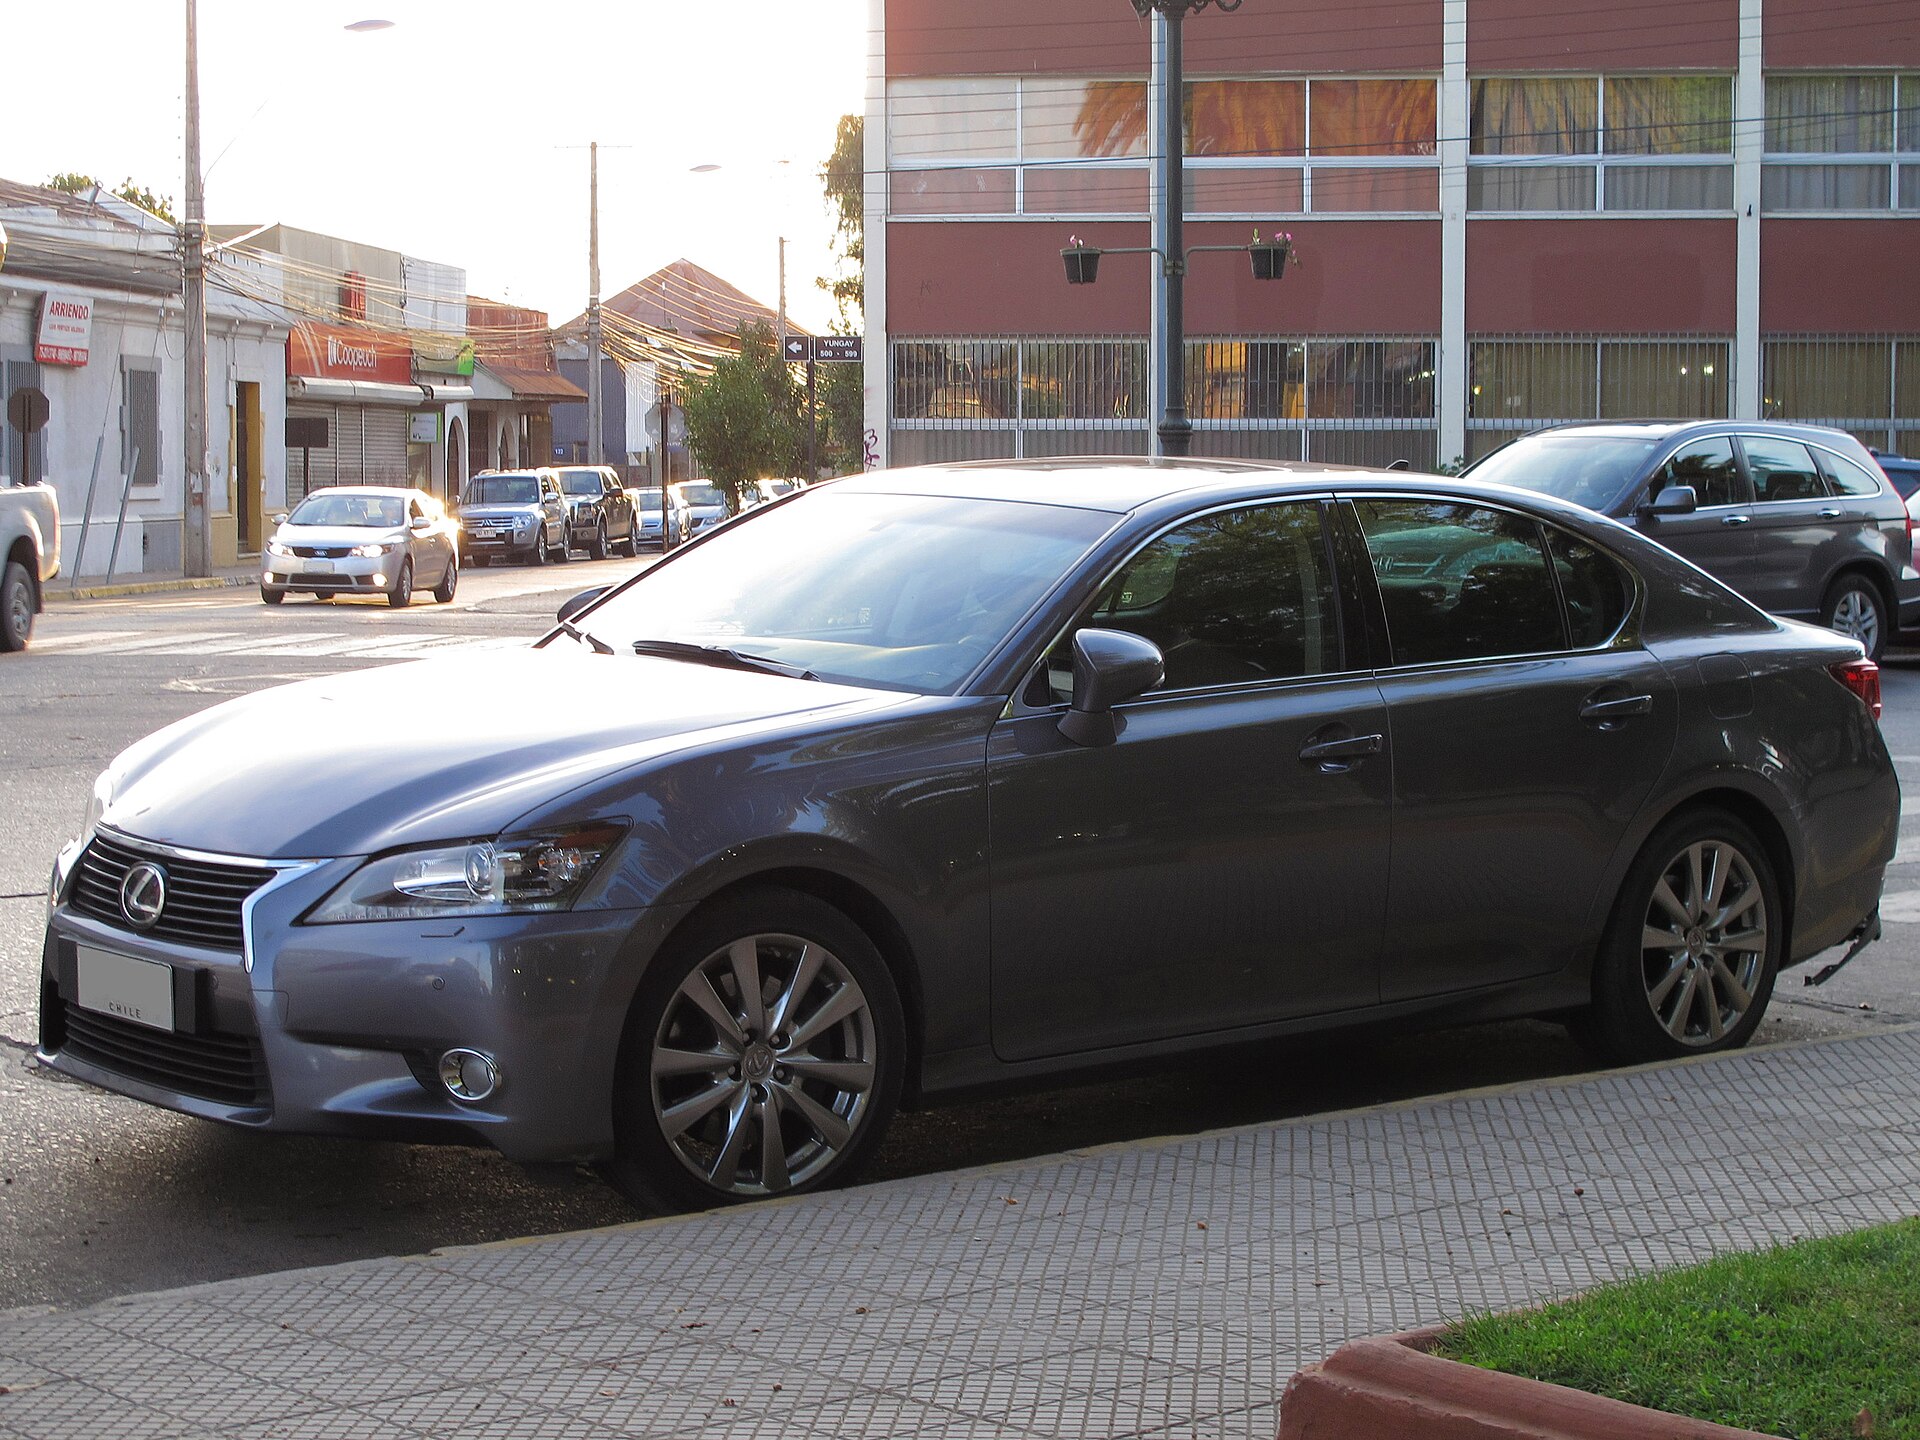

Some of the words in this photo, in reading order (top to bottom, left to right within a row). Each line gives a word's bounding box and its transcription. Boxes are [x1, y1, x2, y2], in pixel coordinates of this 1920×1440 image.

[49, 301, 89, 320] ARRIENDO
[823, 339, 854, 347] YUNGAY
[336, 338, 377, 370] Coopeuch
[109, 1001, 142, 1019] CHILE
